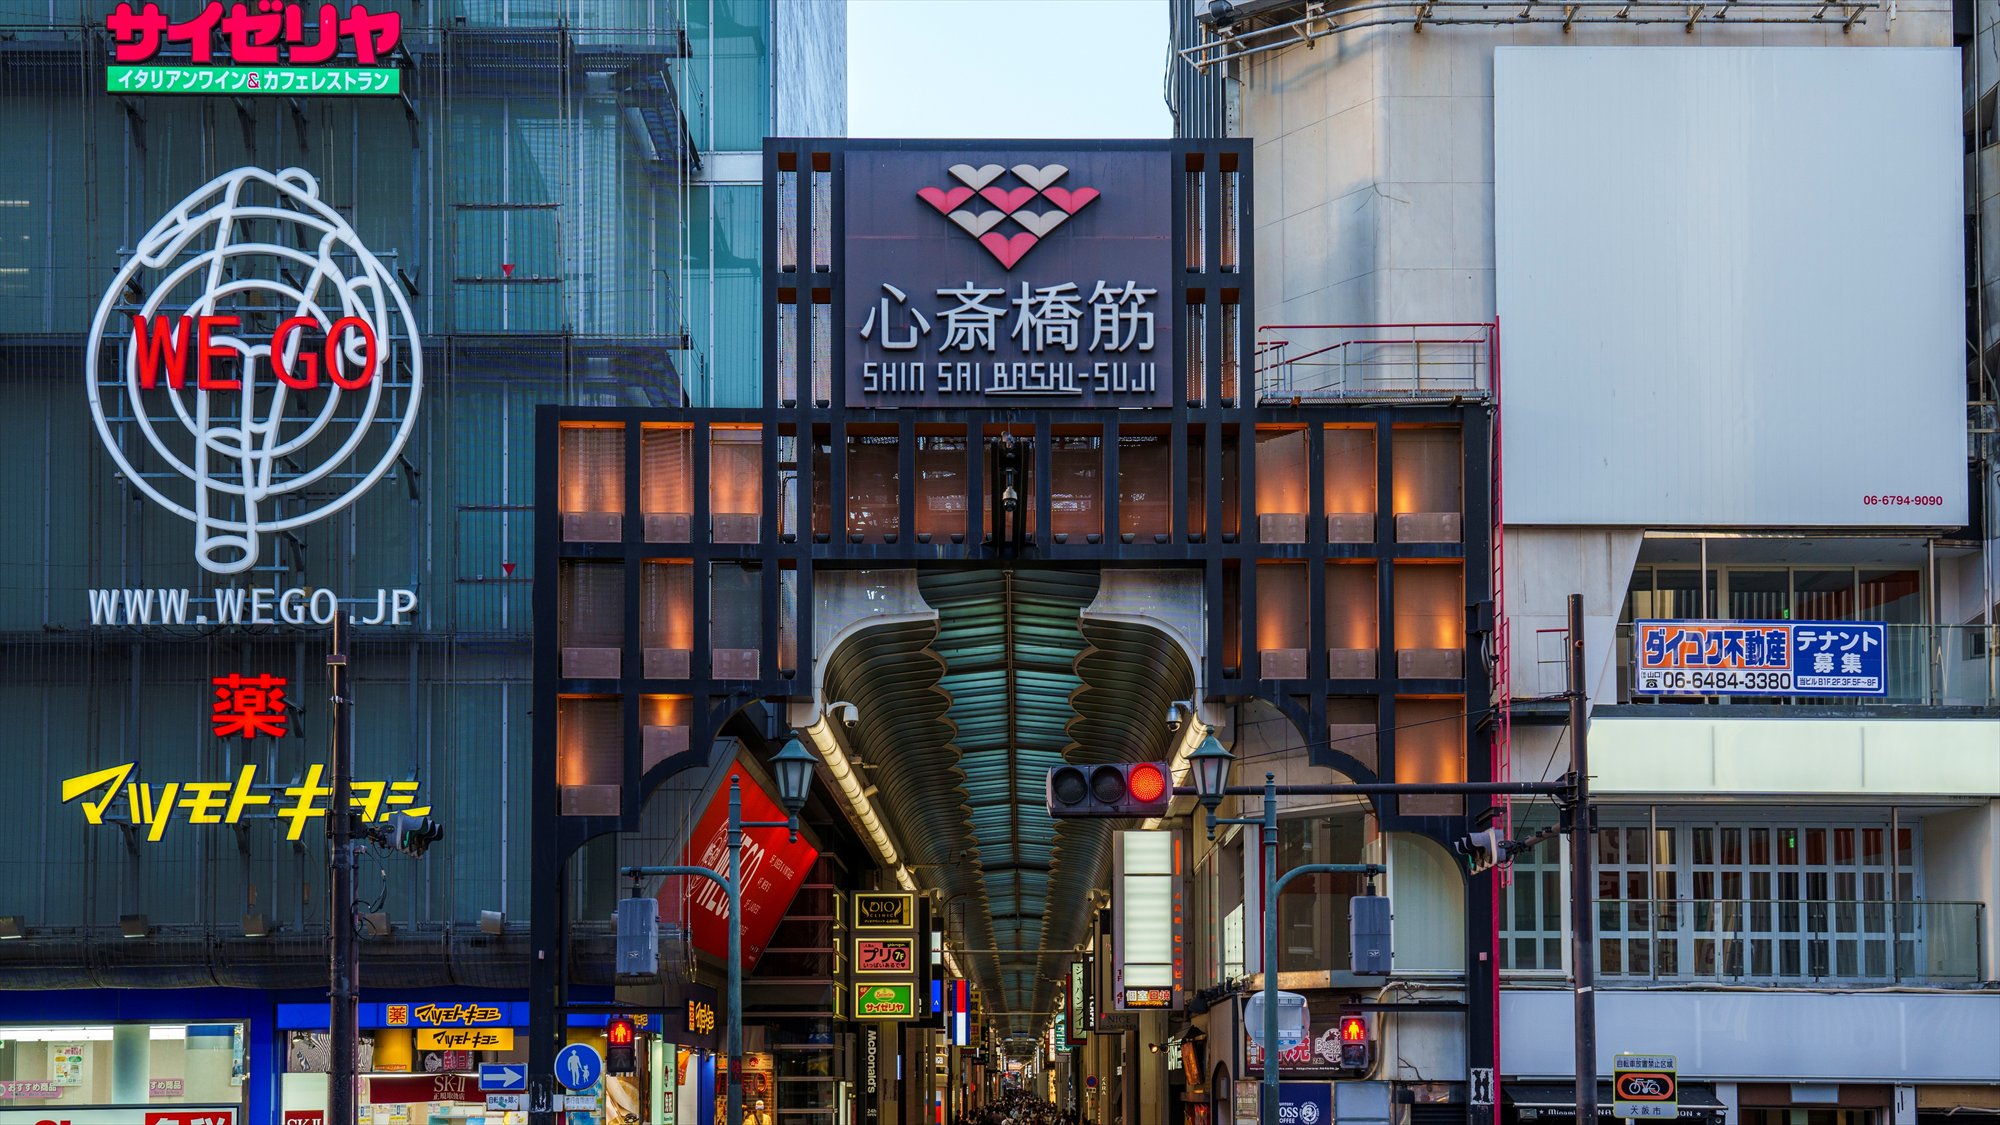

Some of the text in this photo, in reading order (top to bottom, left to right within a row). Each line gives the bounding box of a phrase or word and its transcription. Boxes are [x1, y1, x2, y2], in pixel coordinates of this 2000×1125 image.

[107, 1, 401, 65] サイゼリヤ
[860, 280, 1158, 353] 心斎橋筋
[134, 315, 377, 390] WE GO
[863, 362, 925, 393] SHIN
[938, 362, 982, 393] SAI
[1863, 495, 1943, 506] 06-6794-9090
[1645, 628, 1787, 667] ダイコク不動産
[1797, 630, 1878, 652] テナント
[1813, 652, 1862, 674] 募集
[1663, 672, 1791, 690] 06-6484-3380
[212, 673, 288, 739] 薬
[62, 762, 433, 842] マツモトキヨシ
[864, 948, 891, 964] プリ
[389, 1005, 500, 1025] 薬 マツモトキヨシ
[865, 1003, 904, 1013] サイゼリヤ
[433, 1031, 499, 1048] マツモトキヨシ
[867, 1030, 877, 1094] McDonald's
[1616, 1059, 1674, 1069] 自転車放置禁止区域
[1279, 1107, 1299, 1118] OSS
[1631, 1105, 1661, 1115] 大阪市
